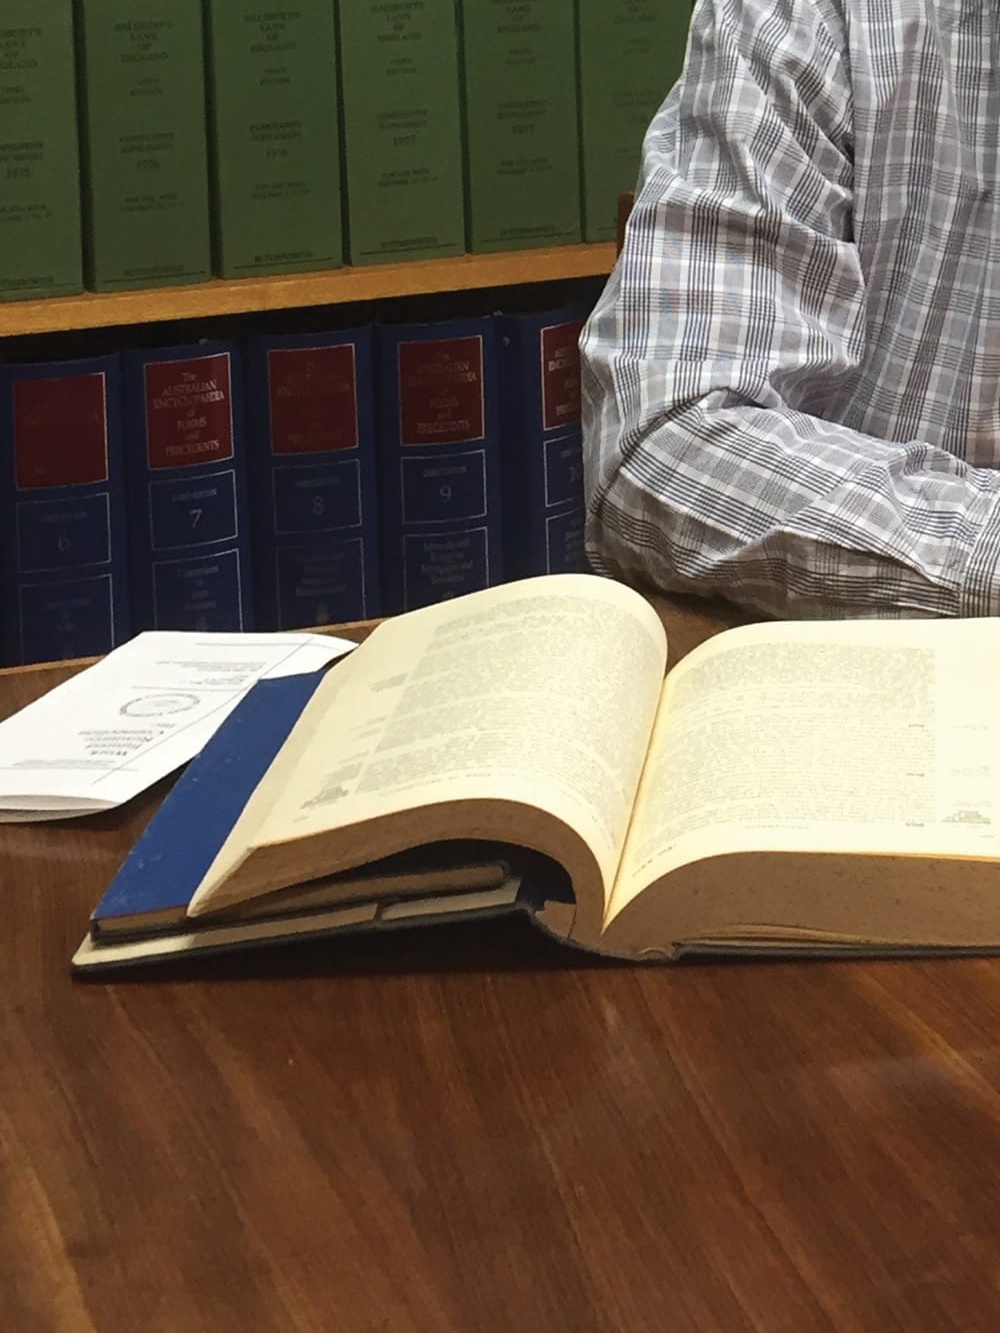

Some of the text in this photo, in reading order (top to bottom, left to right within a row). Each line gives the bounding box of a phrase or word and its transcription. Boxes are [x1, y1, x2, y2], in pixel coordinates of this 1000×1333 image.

[161, 381, 217, 397] AUSTRALIAN
[439, 485, 451, 503] 9
[189, 510, 202, 529] 7
